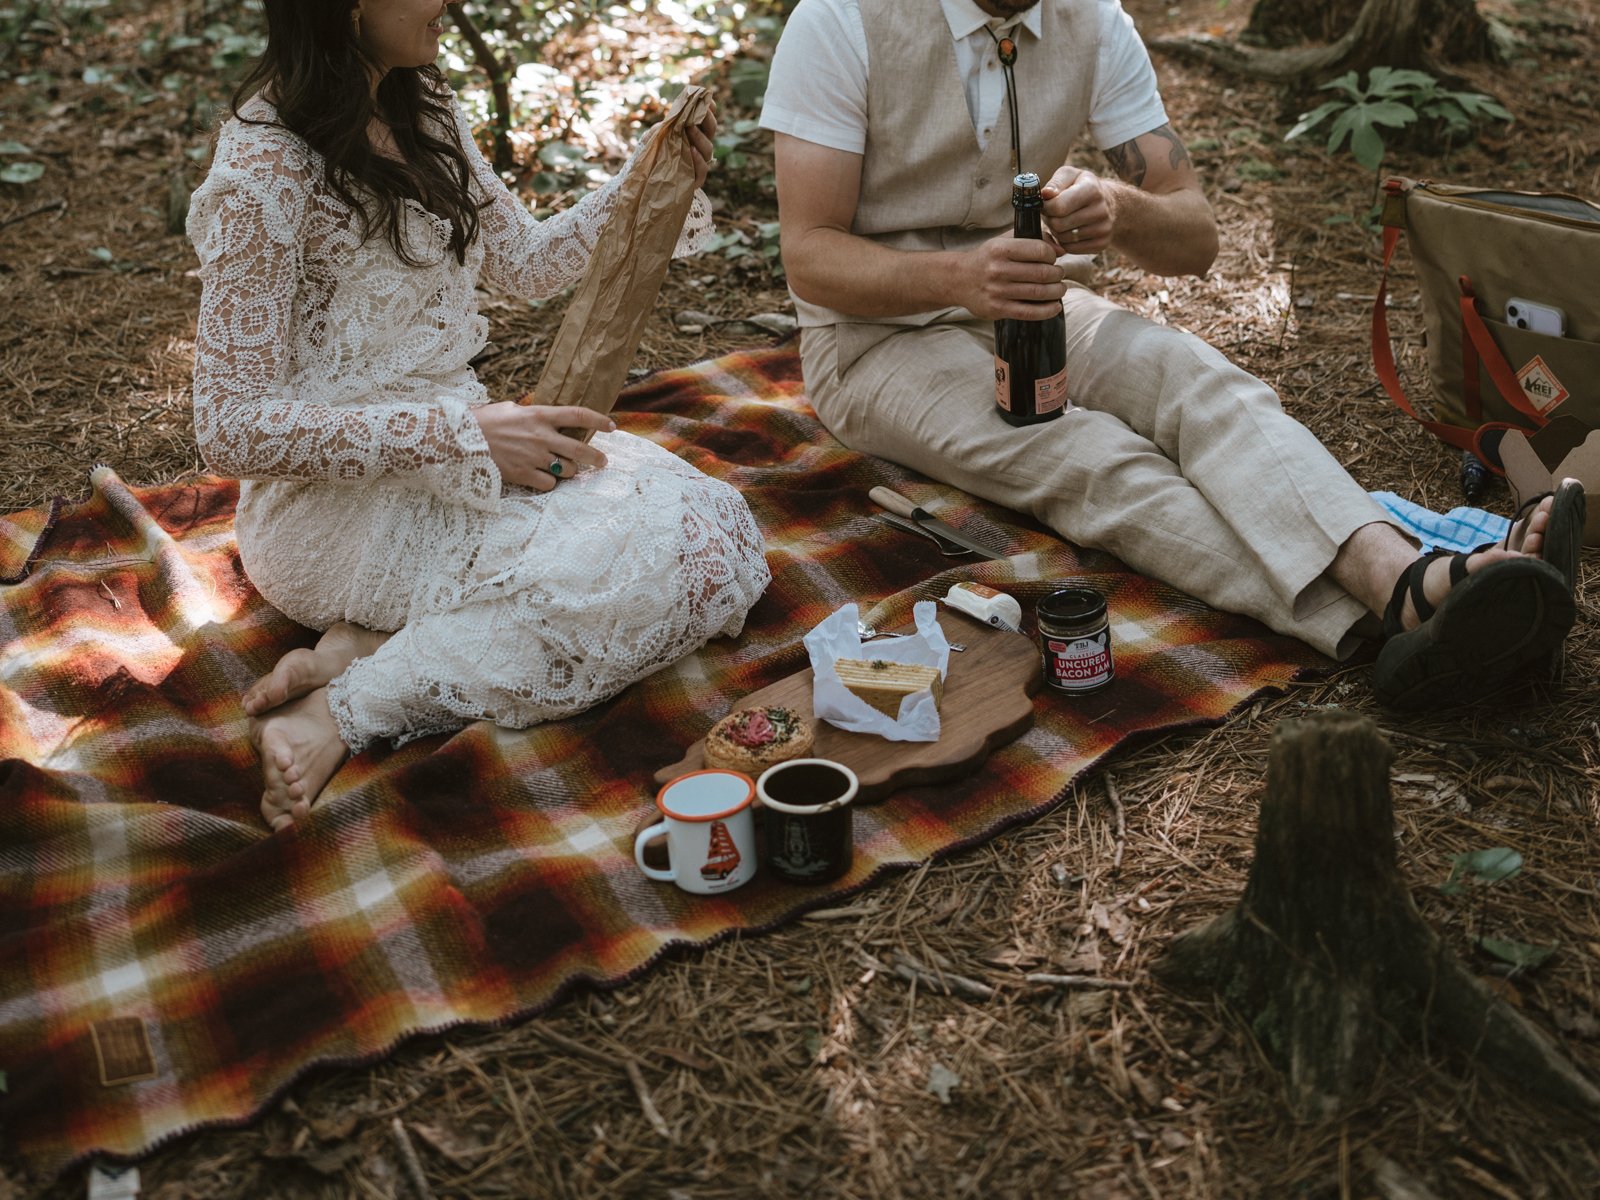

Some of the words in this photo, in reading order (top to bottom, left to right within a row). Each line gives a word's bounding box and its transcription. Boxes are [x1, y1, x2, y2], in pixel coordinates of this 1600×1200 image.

[1533, 383, 1552, 395] REI
[1058, 653, 1106, 669] UNCURED
[1069, 650, 1096, 659] CLASSIC
[1055, 667, 1092, 678] BACON
[1093, 661, 1111, 675] JAM
